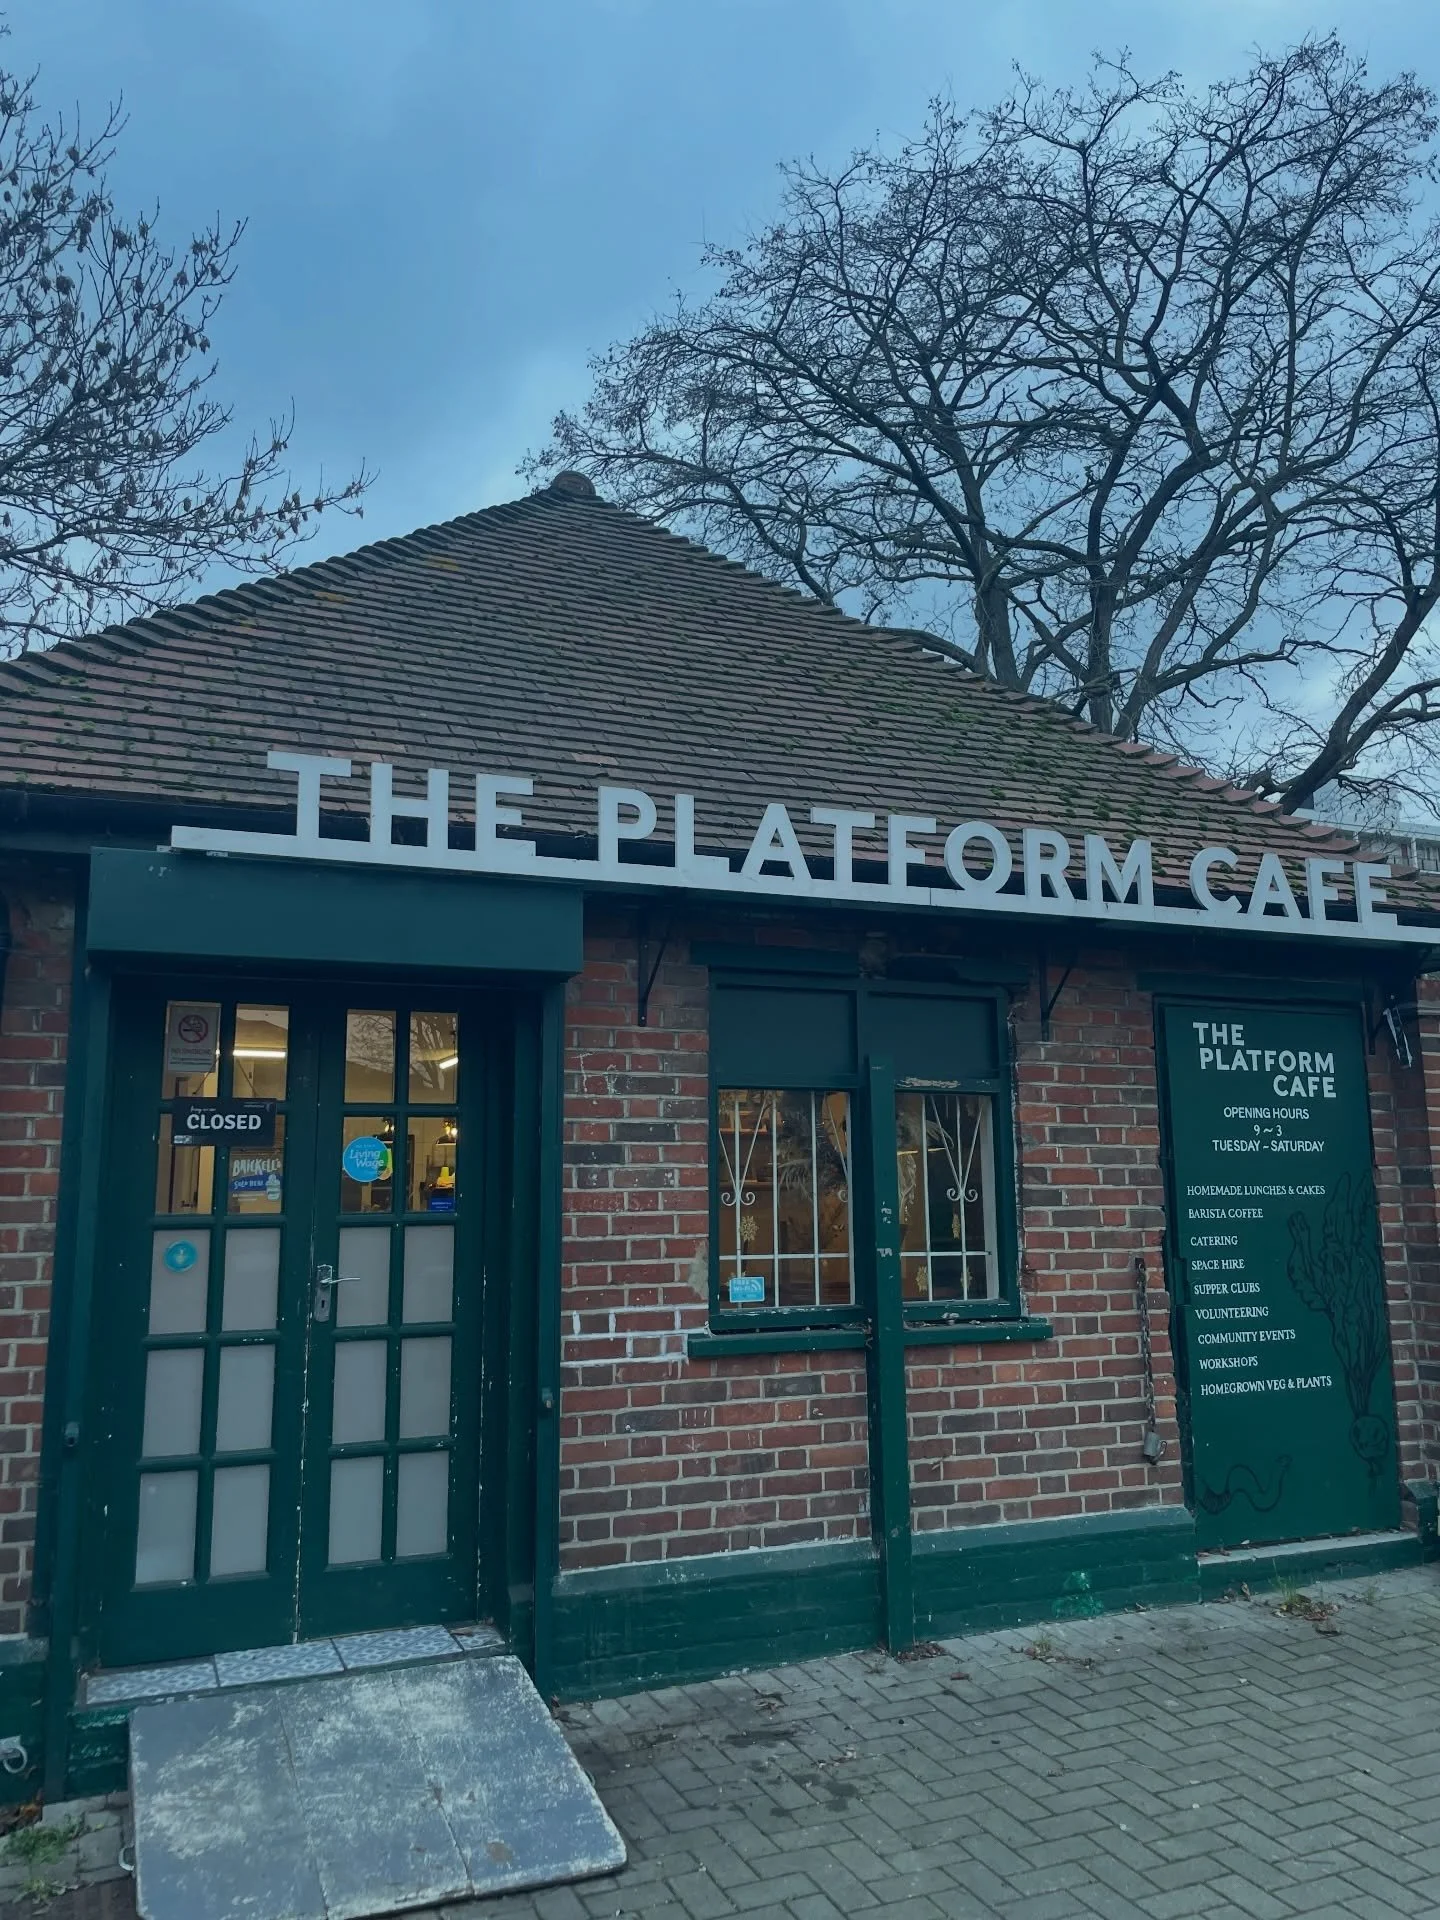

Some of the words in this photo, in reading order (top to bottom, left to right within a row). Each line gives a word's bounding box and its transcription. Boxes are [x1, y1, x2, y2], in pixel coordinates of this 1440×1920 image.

[266, 750, 536, 857] THE
[597, 785, 1155, 912] PLATFORM
[1189, 846, 1398, 928] CAFE
[1193, 1022, 1244, 1046] THE
[1200, 1048, 1335, 1073] PLATFORM
[1273, 1074, 1336, 1098] CAFE
[1224, 1107, 1270, 1119] OPENING
[1273, 1108, 1309, 1119] HOURS
[186, 1113, 262, 1130] CLOSED
[1253, 1125, 1260, 1136] 9
[1276, 1125, 1282, 1136] 3
[1212, 1140, 1260, 1151] TUESDAY
[1271, 1141, 1324, 1152] SATURDAY
[350, 1149, 380, 1160] Living
[356, 1158, 384, 1169] Wage
[1187, 1186, 1242, 1195] HOMEMADE
[1244, 1186, 1286, 1195] LUNCHES
[1288, 1186, 1294, 1195] &
[1296, 1186, 1325, 1195] CAKES
[1189, 1209, 1227, 1218] BARISTA
[1228, 1209, 1263, 1218] COFFEE
[1190, 1236, 1238, 1246] CATERING
[1192, 1260, 1219, 1270] SPACE
[1222, 1259, 1245, 1269] HIRE
[1194, 1284, 1228, 1295] SUPPER
[1231, 1283, 1260, 1293] CLUBS
[1195, 1307, 1269, 1319] VOLUNTEERING
[1198, 1331, 1258, 1344] COMMUNITY
[1259, 1329, 1295, 1341] EVENTS
[1199, 1356, 1258, 1369] WORKSHOPS
[1201, 1380, 1264, 1395] HOMEGROWN
[1266, 1379, 1285, 1391] VEG
[1288, 1379, 1295, 1389] &
[1296, 1376, 1332, 1389] PLANTS
